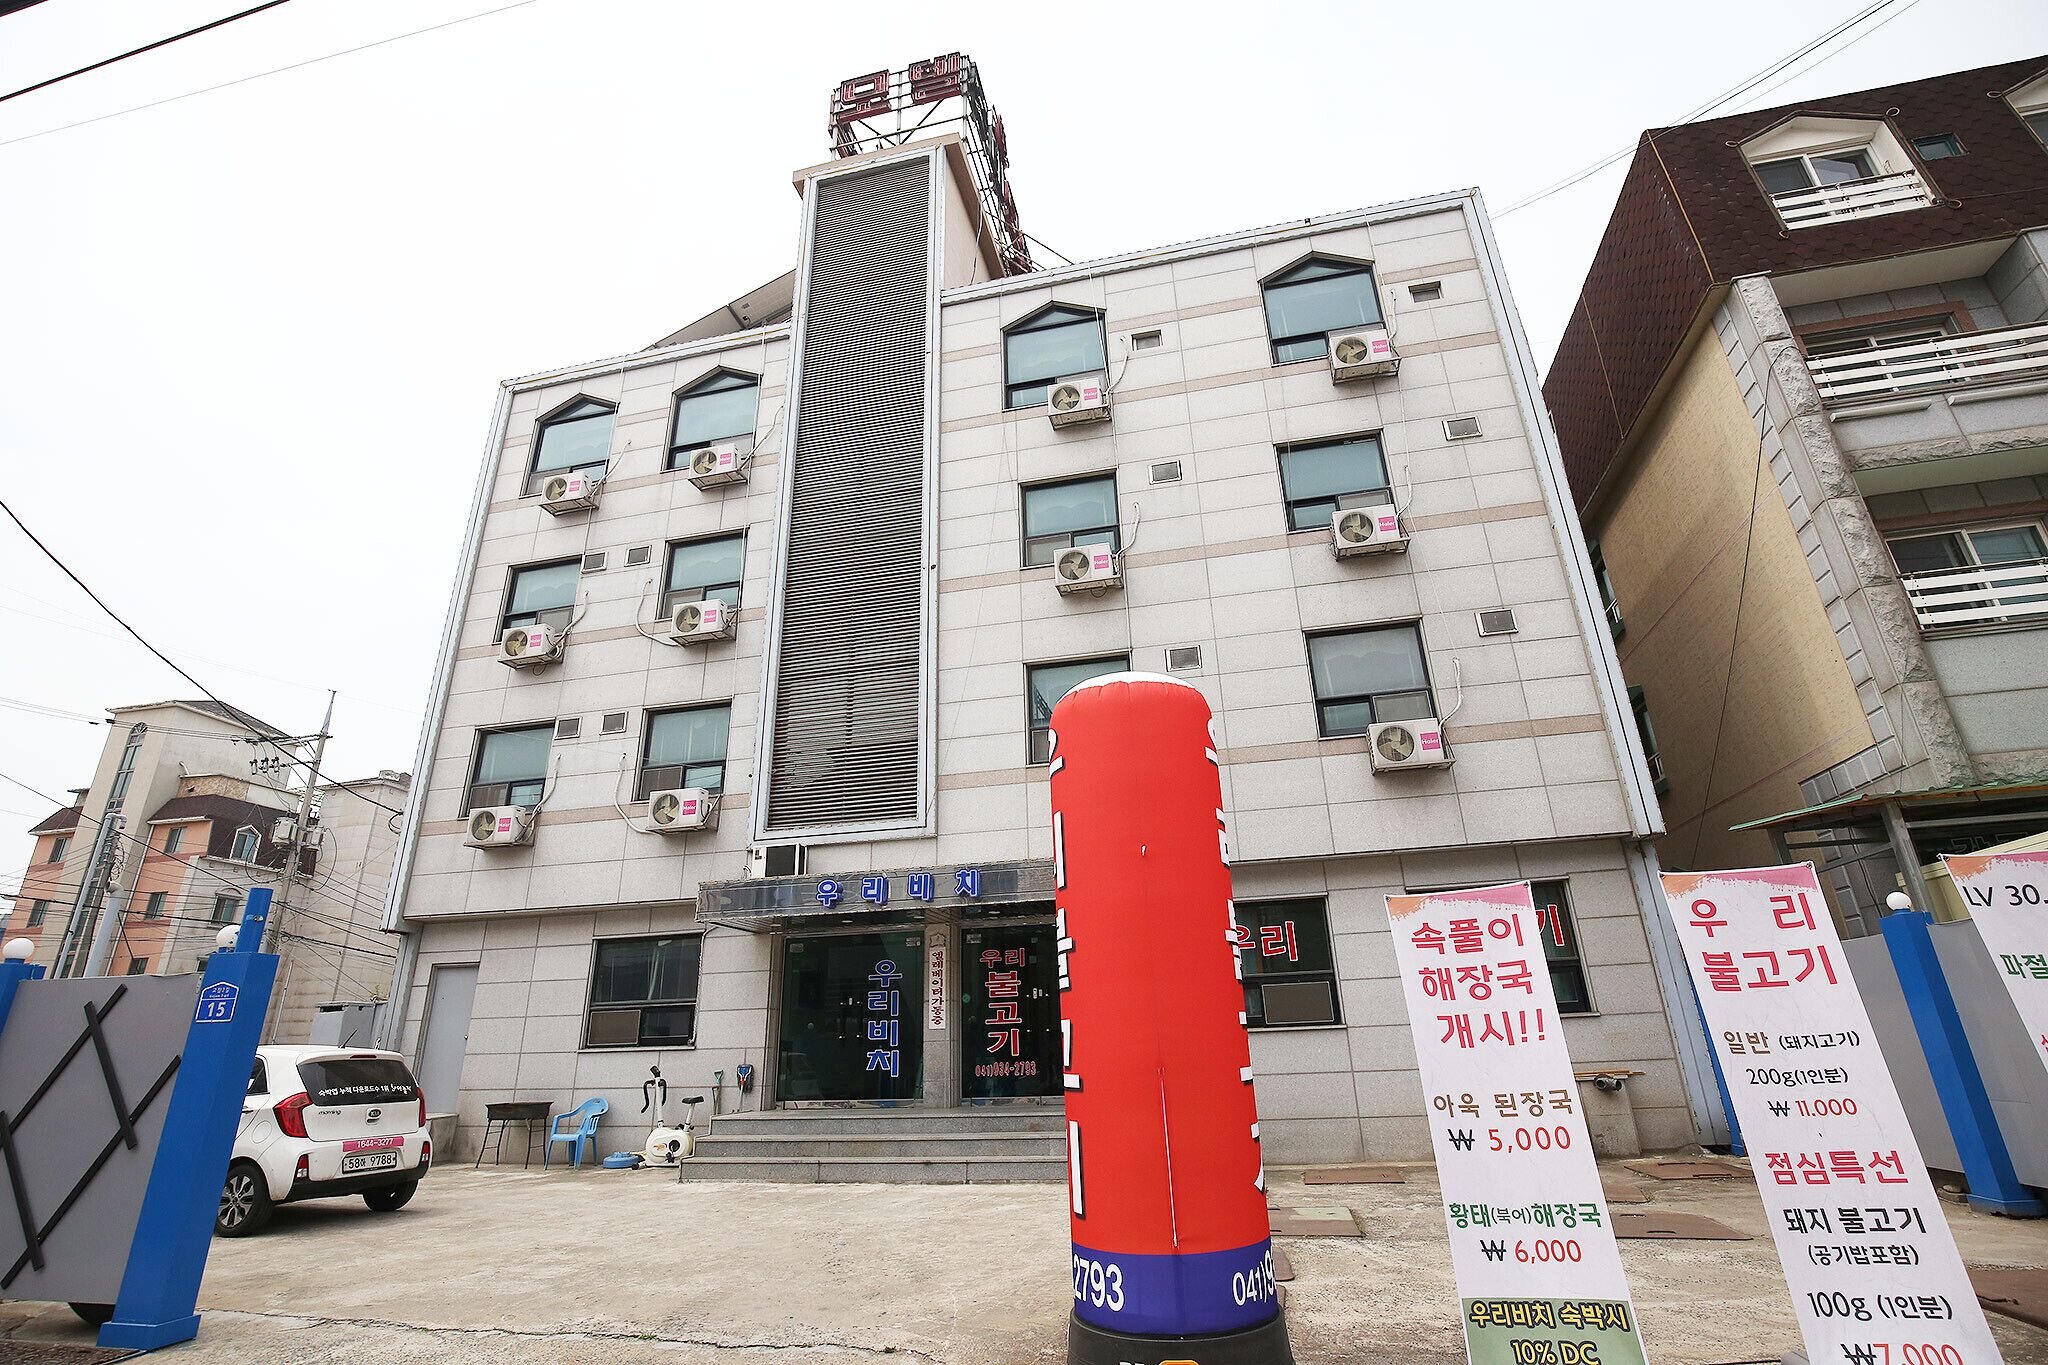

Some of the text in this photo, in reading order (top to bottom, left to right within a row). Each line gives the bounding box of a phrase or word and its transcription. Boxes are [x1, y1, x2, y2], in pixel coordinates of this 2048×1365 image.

[837, 52, 962, 124] 모텔
[816, 869, 981, 908] 우리비치
[1962, 884, 2048, 907] LV 30
[1411, 914, 1524, 955] 속풀이
[979, 948, 1026, 968] 우리
[1702, 945, 1837, 992] 불고기
[1418, 959, 1533, 1001] 해장국
[208, 1002, 226, 1017] 15
[866, 960, 902, 1077] 우리비치
[984, 970, 1022, 1057] 불고기
[1437, 1008, 1545, 1049] 개시!!
[1723, 1030, 1860, 1055] 일반 (돼지고기)
[1745, 1067, 1849, 1087] 200g(1인분)
[1433, 1089, 1573, 1118] 아욱 된장국
[1796, 1098, 1858, 1117] 11.000
[1448, 1126, 1571, 1153] ₩ 5,000
[370, 1155, 392, 1166] 9788
[1765, 1150, 1908, 1185] 점심특선
[1449, 1203, 1602, 1229] 황태(북어)해장국
[1783, 1207, 1927, 1234] 돼지 불고기
[1480, 1239, 1582, 1264] ₩ 6,000
[1808, 1244, 1919, 1265] (공기밥포함)
[1232, 1250, 1277, 1306] 041)9
[1470, 1300, 1630, 1332] 우리비치 숙박시
[1807, 1292, 1953, 1322] 100g (1인분)
[1511, 1339, 1600, 1365] 10% DC
